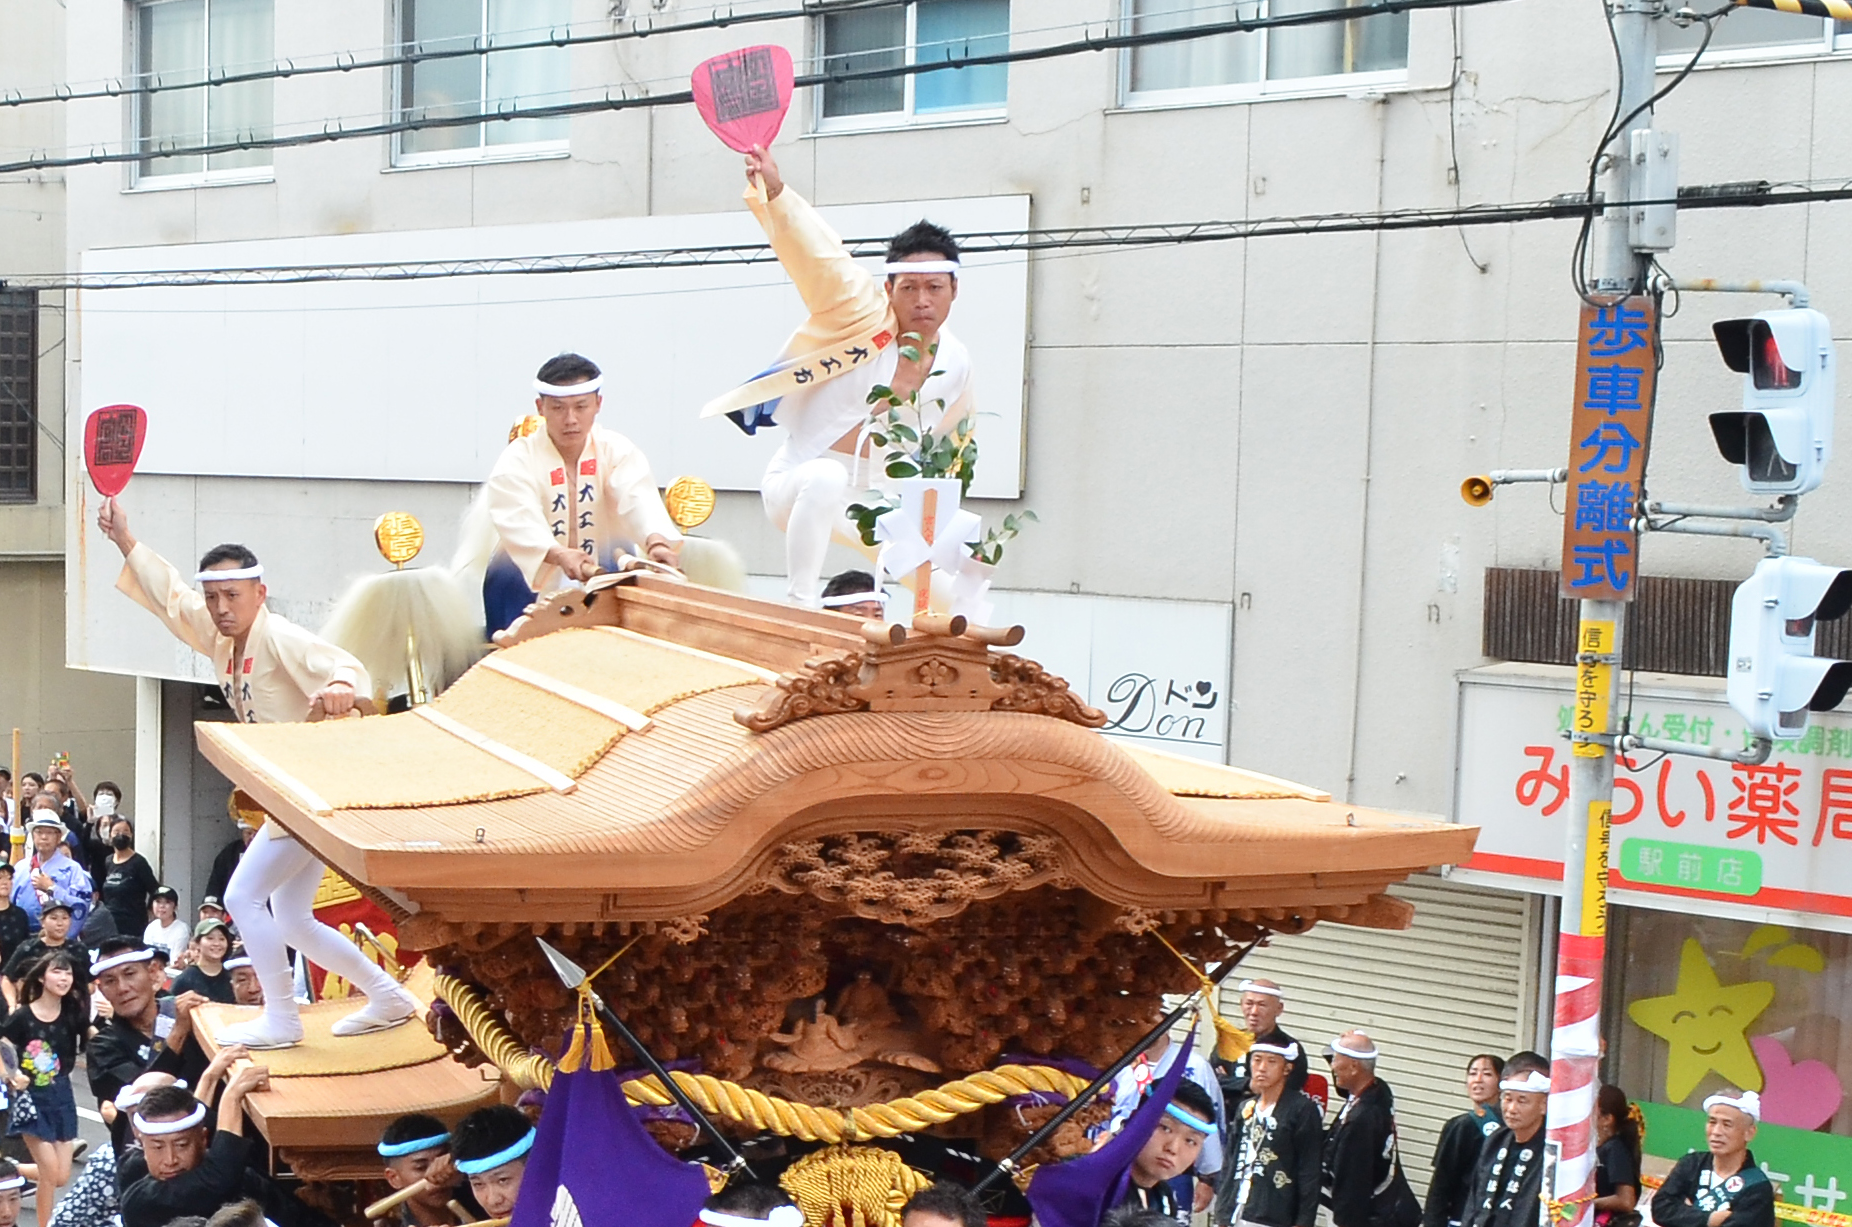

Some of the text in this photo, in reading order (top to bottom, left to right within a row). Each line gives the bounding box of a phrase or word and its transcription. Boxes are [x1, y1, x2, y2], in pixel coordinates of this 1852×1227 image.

[1571, 304, 1649, 593] 歩車分離式
[1100, 673, 1205, 739] Don
[1638, 846, 1744, 887] 駅前店
